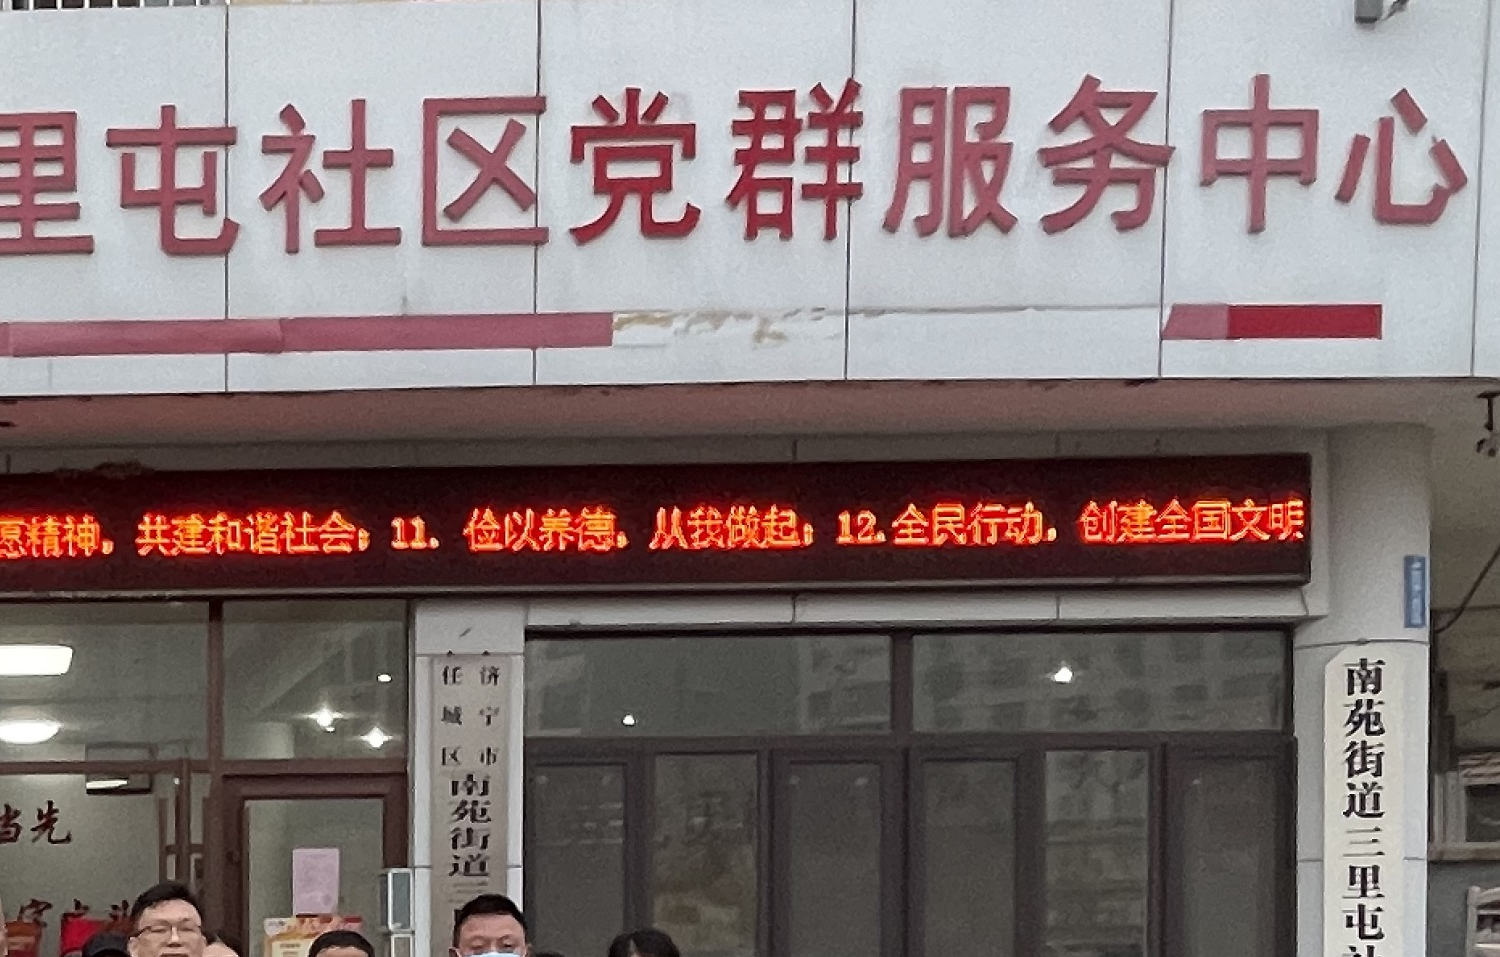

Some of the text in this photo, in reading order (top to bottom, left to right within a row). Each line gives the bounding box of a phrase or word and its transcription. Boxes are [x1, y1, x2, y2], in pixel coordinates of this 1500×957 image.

[441, 665, 464, 767] 任城区
[479, 665, 501, 767] 济宁市
